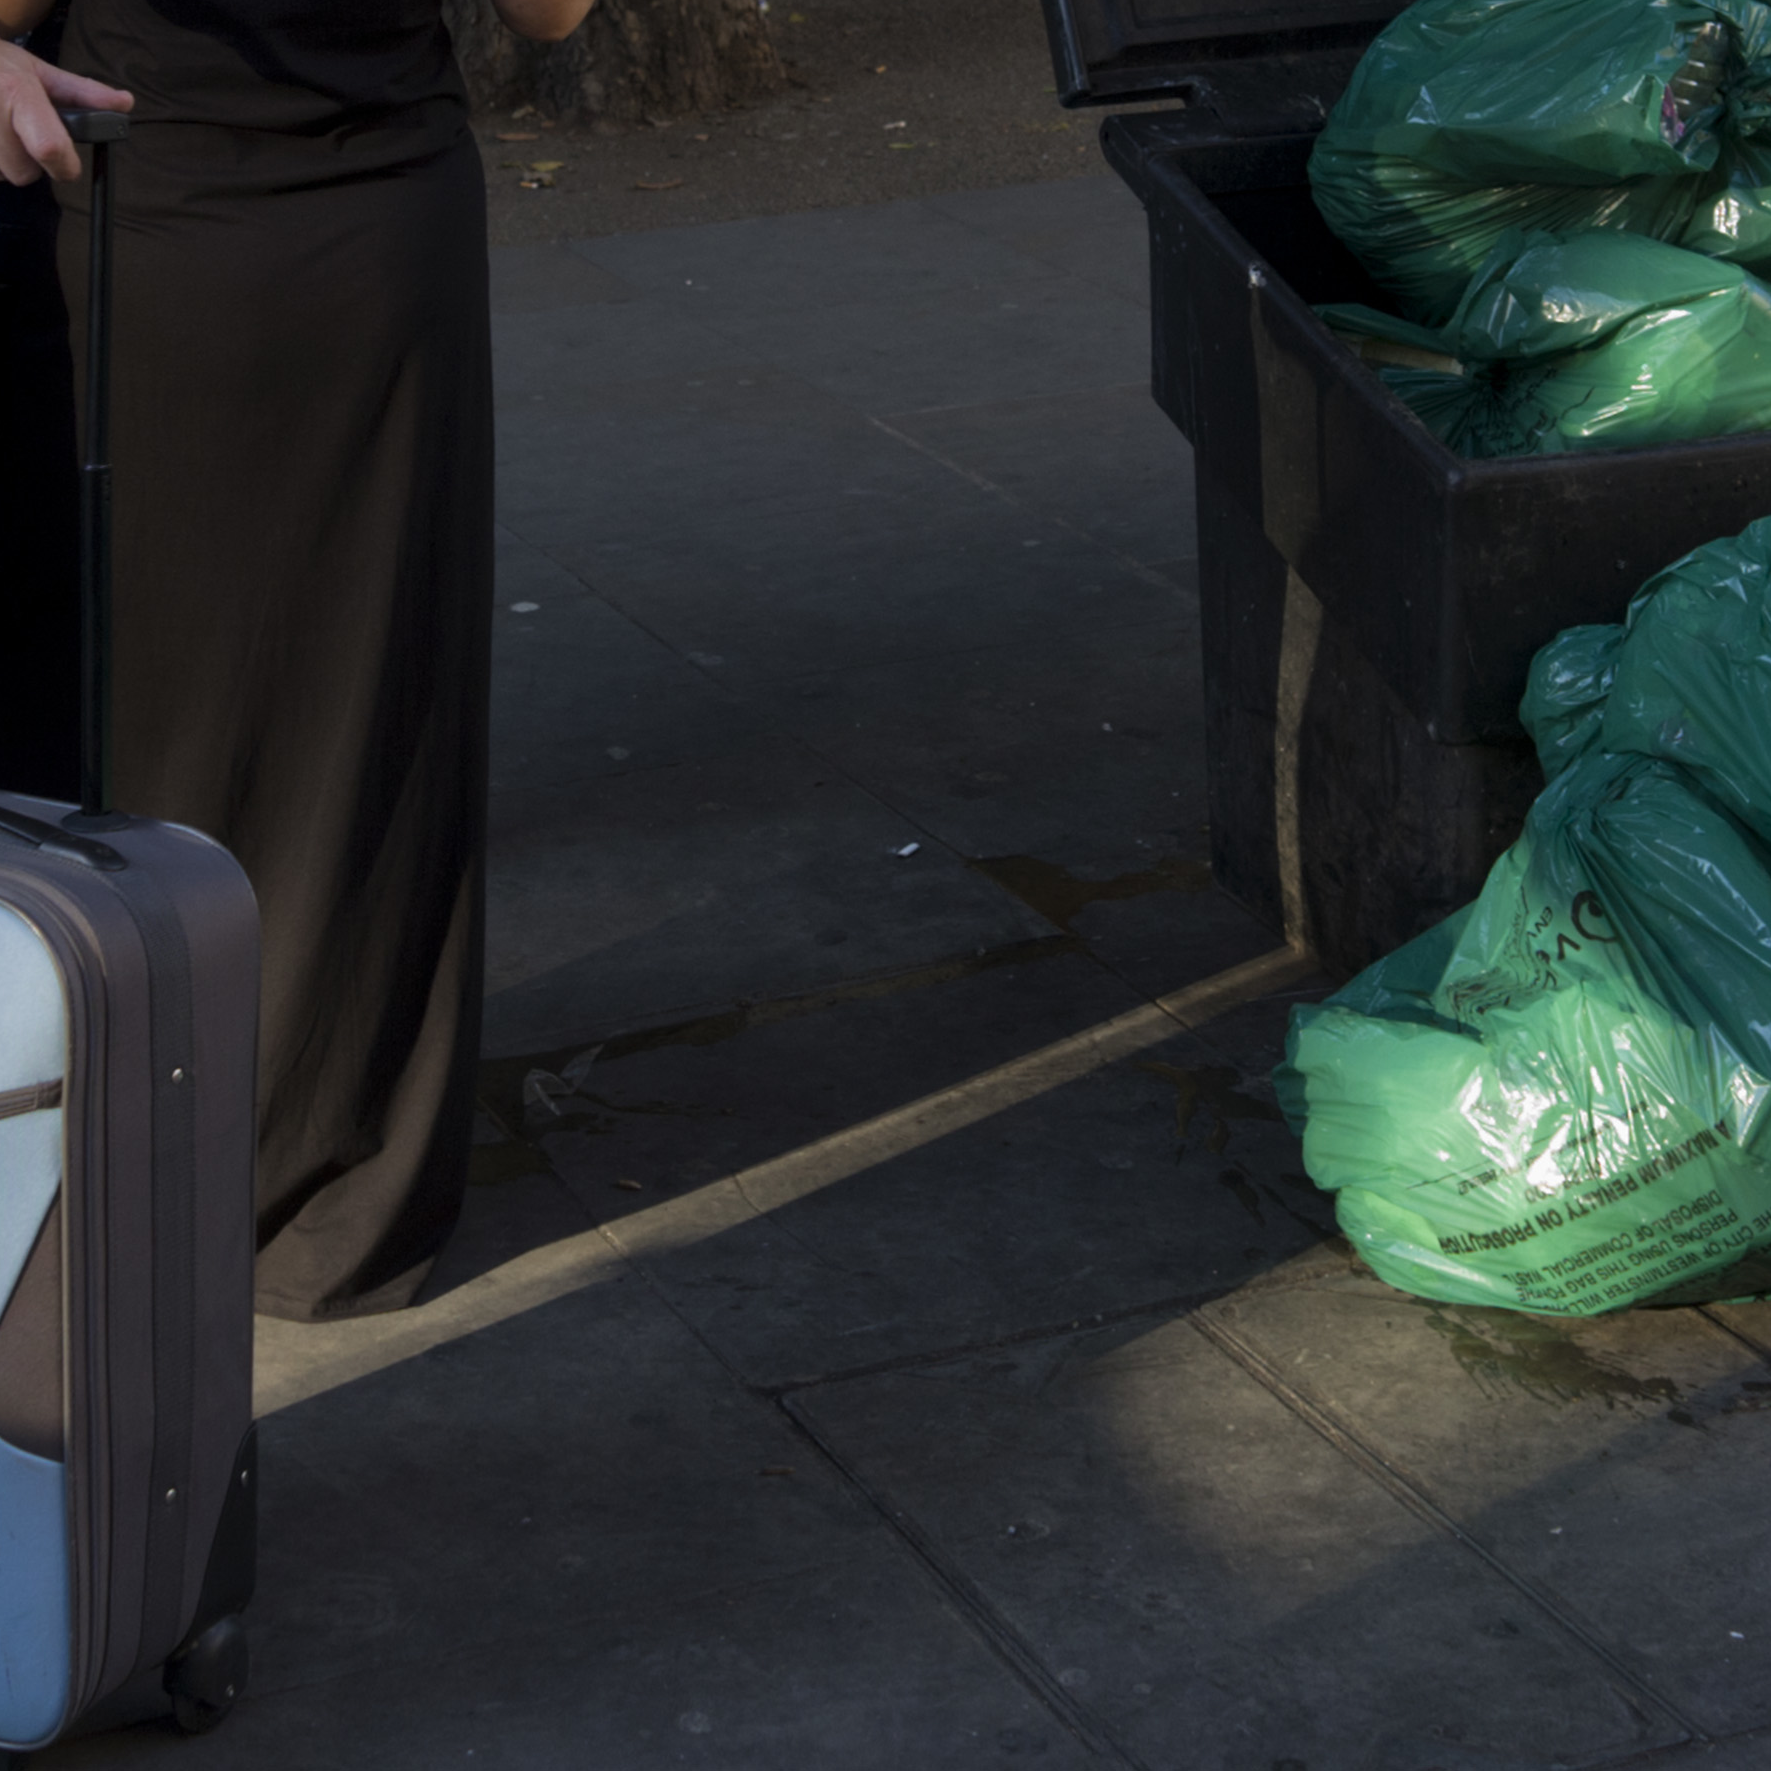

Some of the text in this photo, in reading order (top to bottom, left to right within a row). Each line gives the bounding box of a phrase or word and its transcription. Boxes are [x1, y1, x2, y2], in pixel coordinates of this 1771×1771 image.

[1717, 1119, 1732, 1140] A
[1638, 1128, 1720, 1186] MAXIMUM
[1566, 1168, 1640, 1222] PENALTY
[1534, 1210, 1564, 1232] ON
[1659, 1188, 1724, 1233] DISPOSAL
[1634, 1226, 1657, 1244] OF
[1676, 1206, 1739, 1249] PERSONS
[1719, 1226, 1754, 1253] CITY
[1542, 1231, 1634, 1280] COMMERCIAL
[1629, 1239, 1673, 1267] USING
[1696, 1241, 1720, 1262] OF
[1595, 1257, 1629, 1280] THIS
[1602, 1249, 1697, 1300] WESTMINSTER
[1570, 1272, 1597, 1293] BAG
